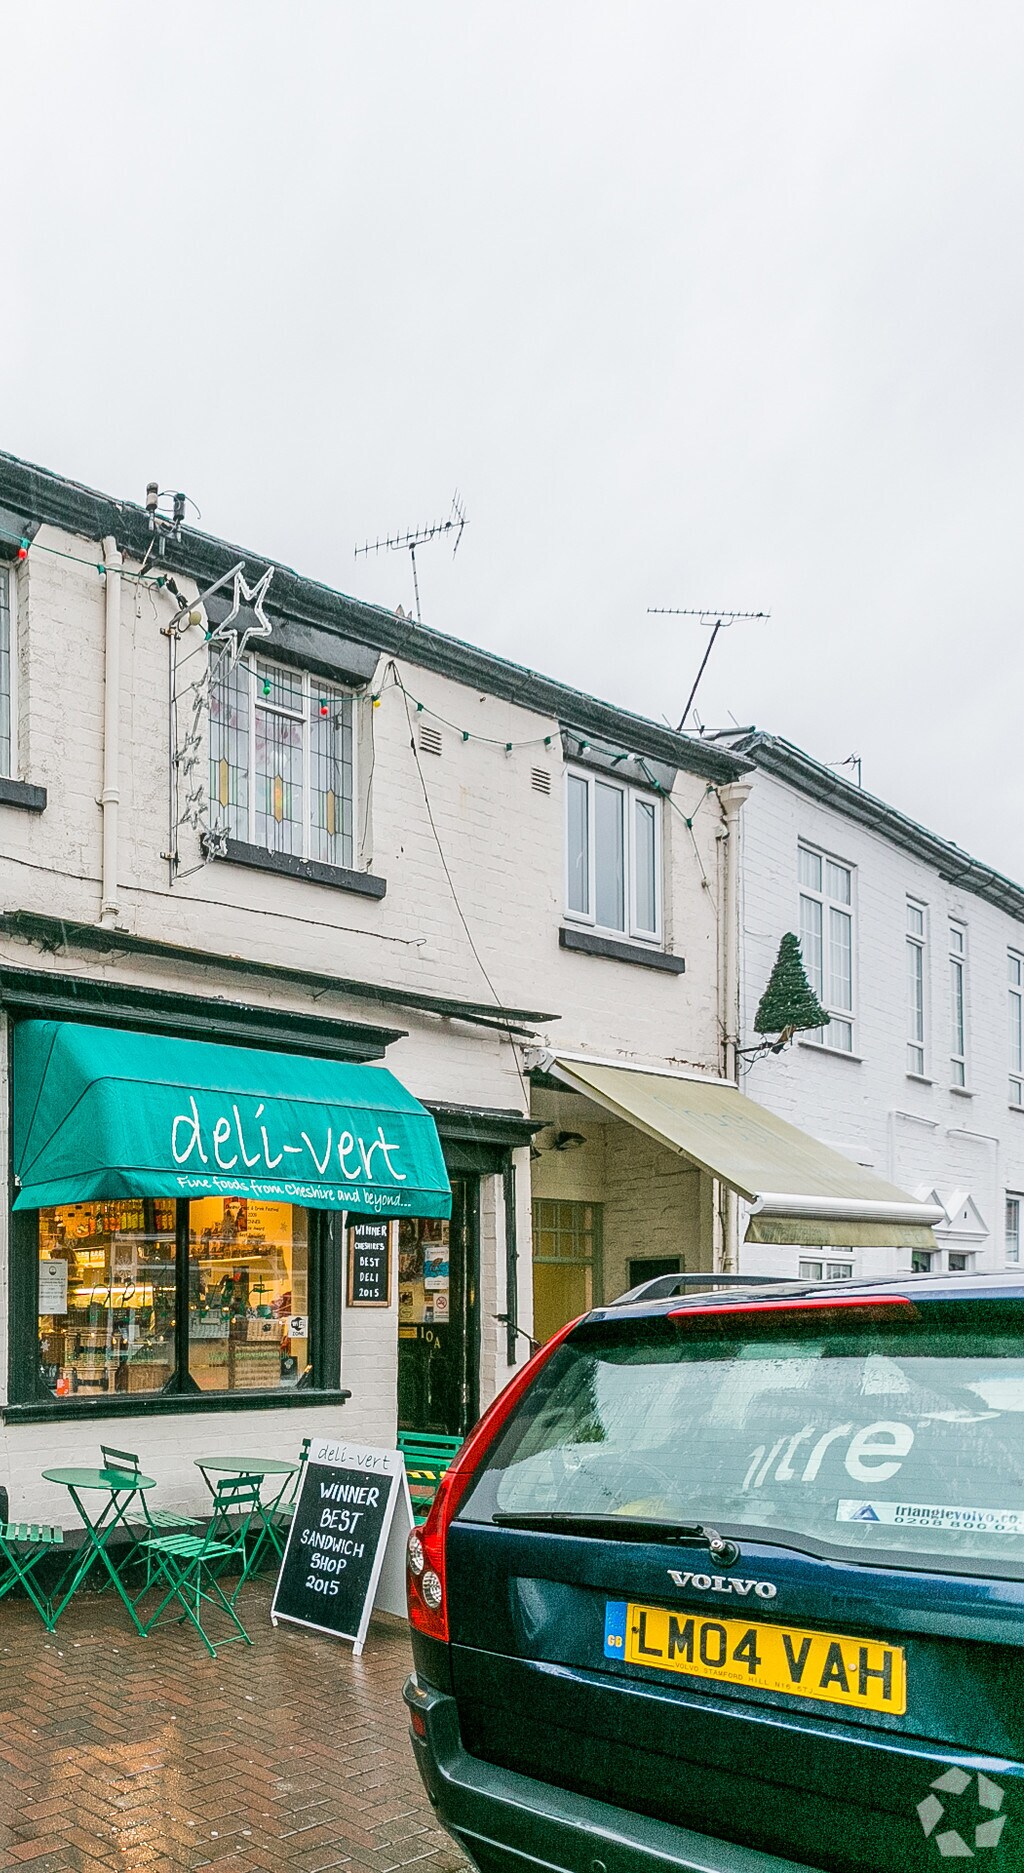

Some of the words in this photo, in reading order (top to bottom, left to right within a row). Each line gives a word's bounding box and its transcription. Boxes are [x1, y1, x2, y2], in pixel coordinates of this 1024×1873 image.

[177, 1176, 212, 1190] Fine
[212, 1175, 250, 1192] foods
[250, 1180, 285, 1196] from
[285, 1184, 335, 1201] Cheshire
[338, 1190, 360, 1203] and
[355, 1225, 387, 1237] WINNER
[359, 1256, 380, 1268] BEST
[359, 1272, 379, 1283] DELI
[358, 1288, 380, 1298] 2015
[317, 1444, 391, 1470] deli-vert
[320, 1482, 380, 1508] WINNER
[320, 1508, 363, 1534] BEST
[894, 1516, 943, 1527] 0208
[300, 1529, 365, 1558] SANDWICH
[310, 1552, 347, 1575] SHOP
[305, 1575, 340, 1595] 2015
[667, 1569, 777, 1599] VOLVO
[607, 1634, 623, 1648] GB
[638, 1611, 762, 1675] LM04
[781, 1634, 893, 1700] VAH
[675, 1662, 699, 1673] VOLVO
[703, 1668, 743, 1680] STAMFORD
[748, 1677, 769, 1686] HILL
